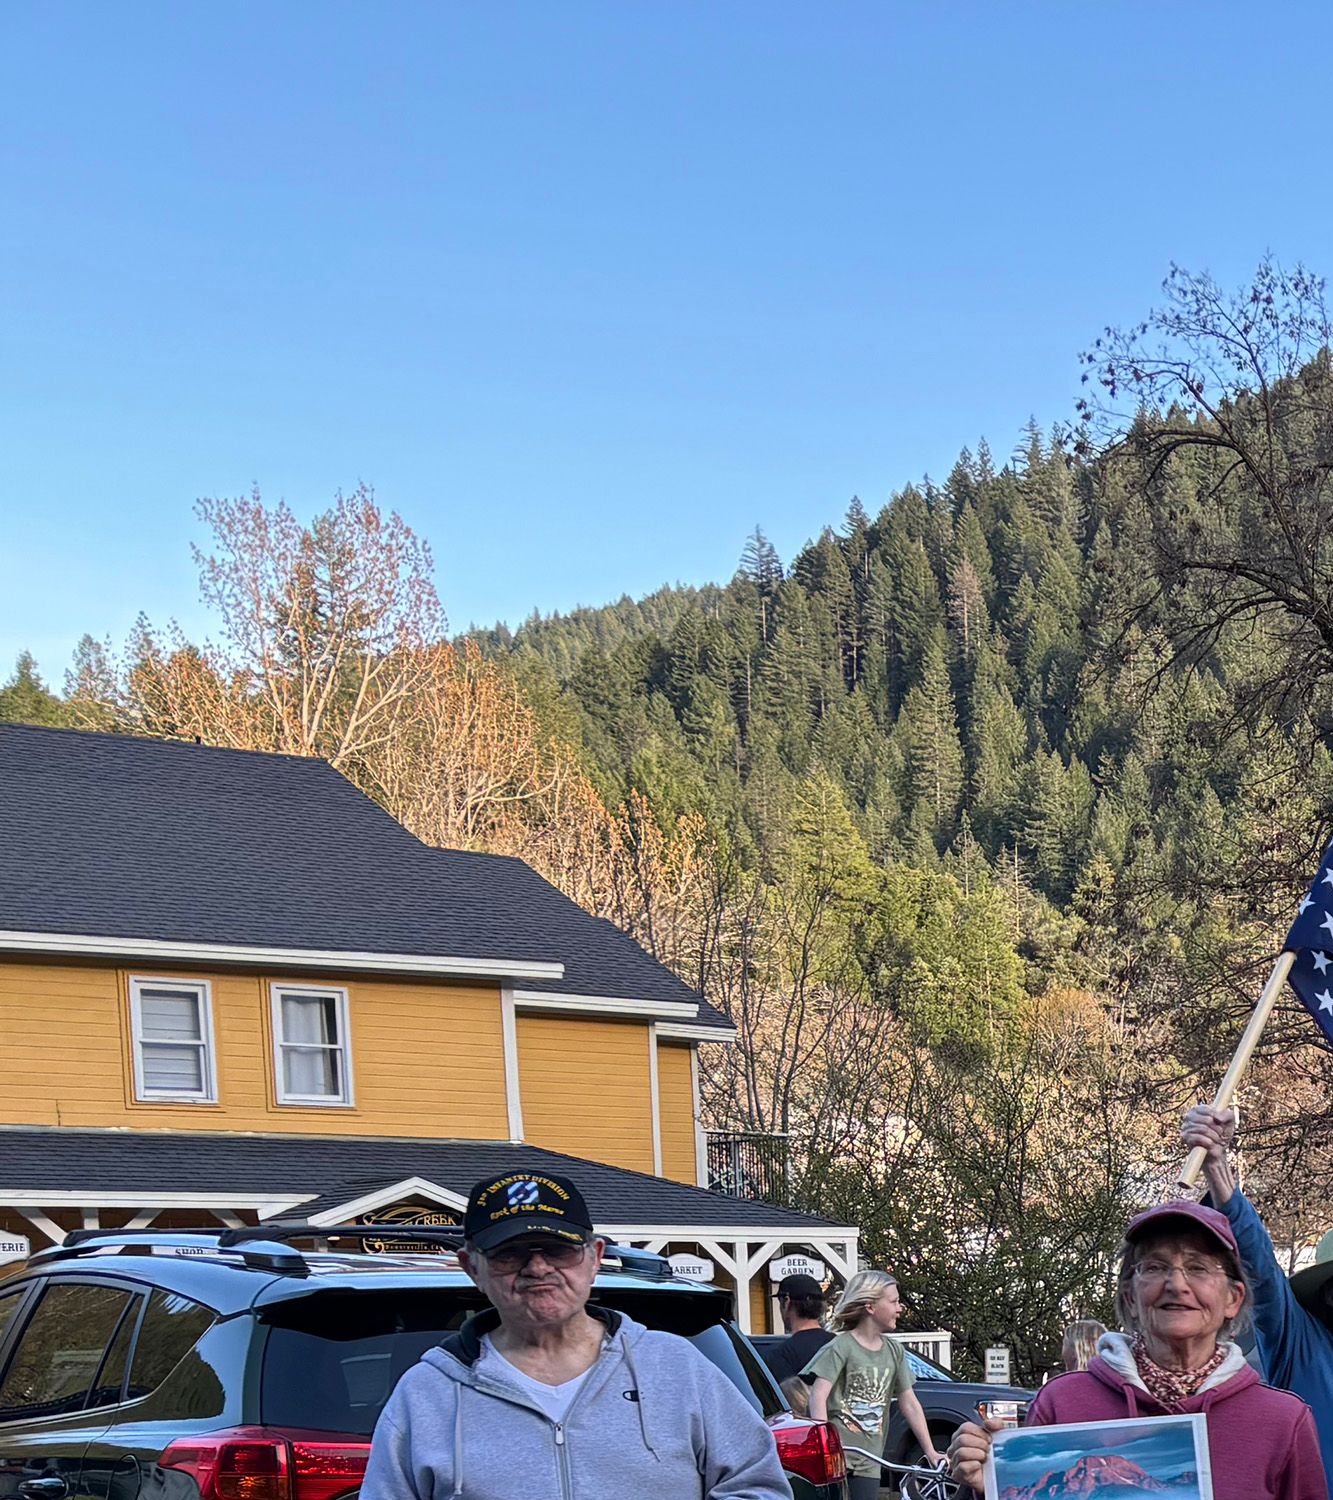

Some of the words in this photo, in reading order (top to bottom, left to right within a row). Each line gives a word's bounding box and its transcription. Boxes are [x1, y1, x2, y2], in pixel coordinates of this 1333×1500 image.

[532, 1175, 571, 1200] DIVISION
[0, 1242, 25, 1251] ERIE
[787, 1258, 808, 1266] BEER
[674, 1265, 703, 1274] ARKET
